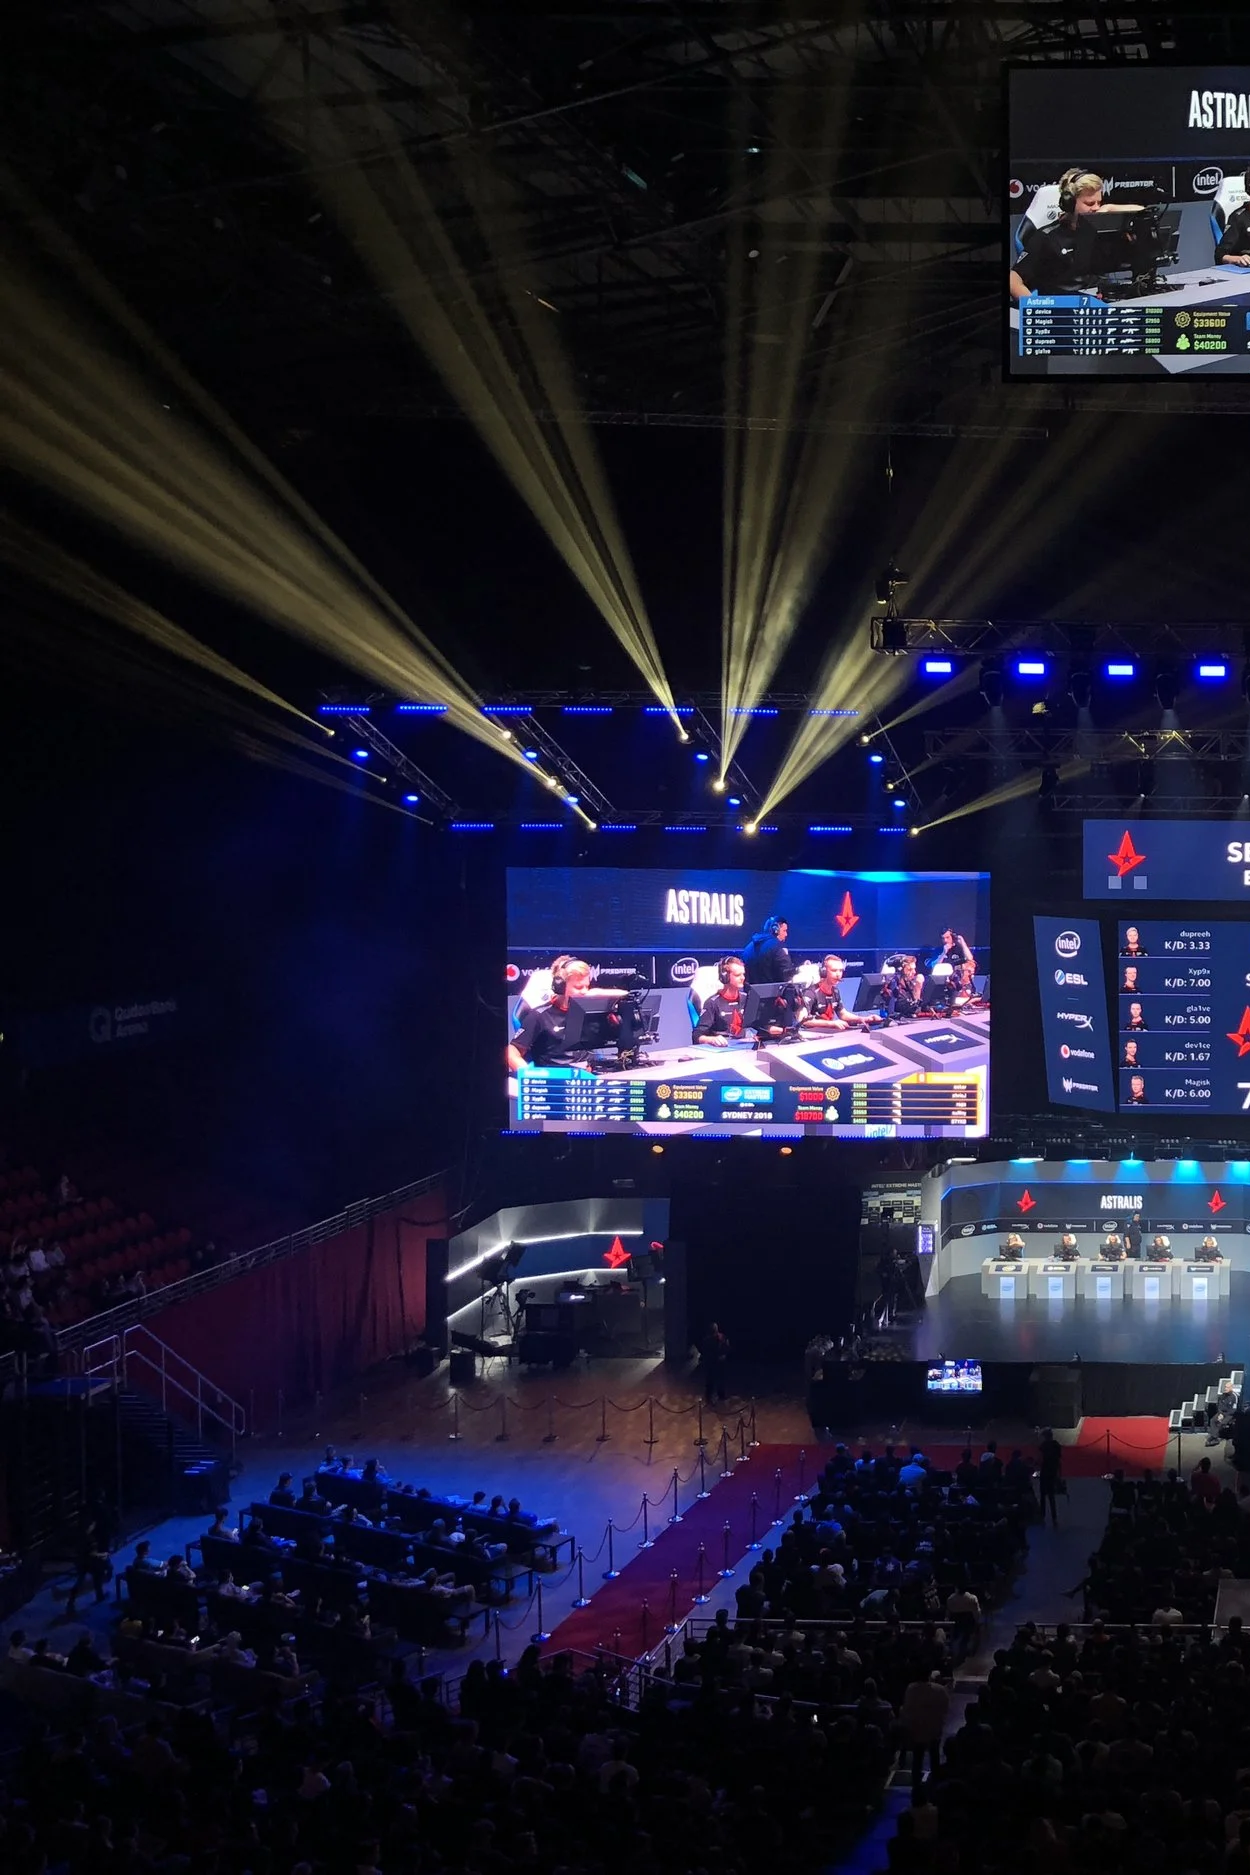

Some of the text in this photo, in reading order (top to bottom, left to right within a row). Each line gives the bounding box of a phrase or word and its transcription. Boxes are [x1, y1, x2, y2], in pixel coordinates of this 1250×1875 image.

[1115, 180, 1154, 190] PREDATOR
[1027, 298, 1055, 306] Astralis
[1082, 297, 1088, 305] 7
[1194, 319, 1226, 328] $33600
[1194, 341, 1227, 350] $40200
[666, 889, 744, 926] ASTRALIS
[1180, 930, 1211, 938] dupreeh
[1164, 941, 1211, 950] K/D: 3.33
[600, 967, 636, 975] PREDATOR
[1066, 973, 1088, 985] ESL
[1164, 978, 1211, 987] K/D: 7.00
[1057, 1012, 1093, 1032] HYPERX
[1164, 1015, 1211, 1024] K/D: 5.00
[1070, 1049, 1095, 1059] vodafone
[1164, 1052, 1211, 1061] K/D: 1.67
[1185, 1078, 1211, 1087] Magisk
[673, 1091, 702, 1100] $33600
[800, 1092, 824, 1101] $1000
[1164, 1089, 1211, 1098] K/D: 6.00
[674, 1110, 704, 1119] $40200
[1101, 1195, 1142, 1209] ASTRALIS
